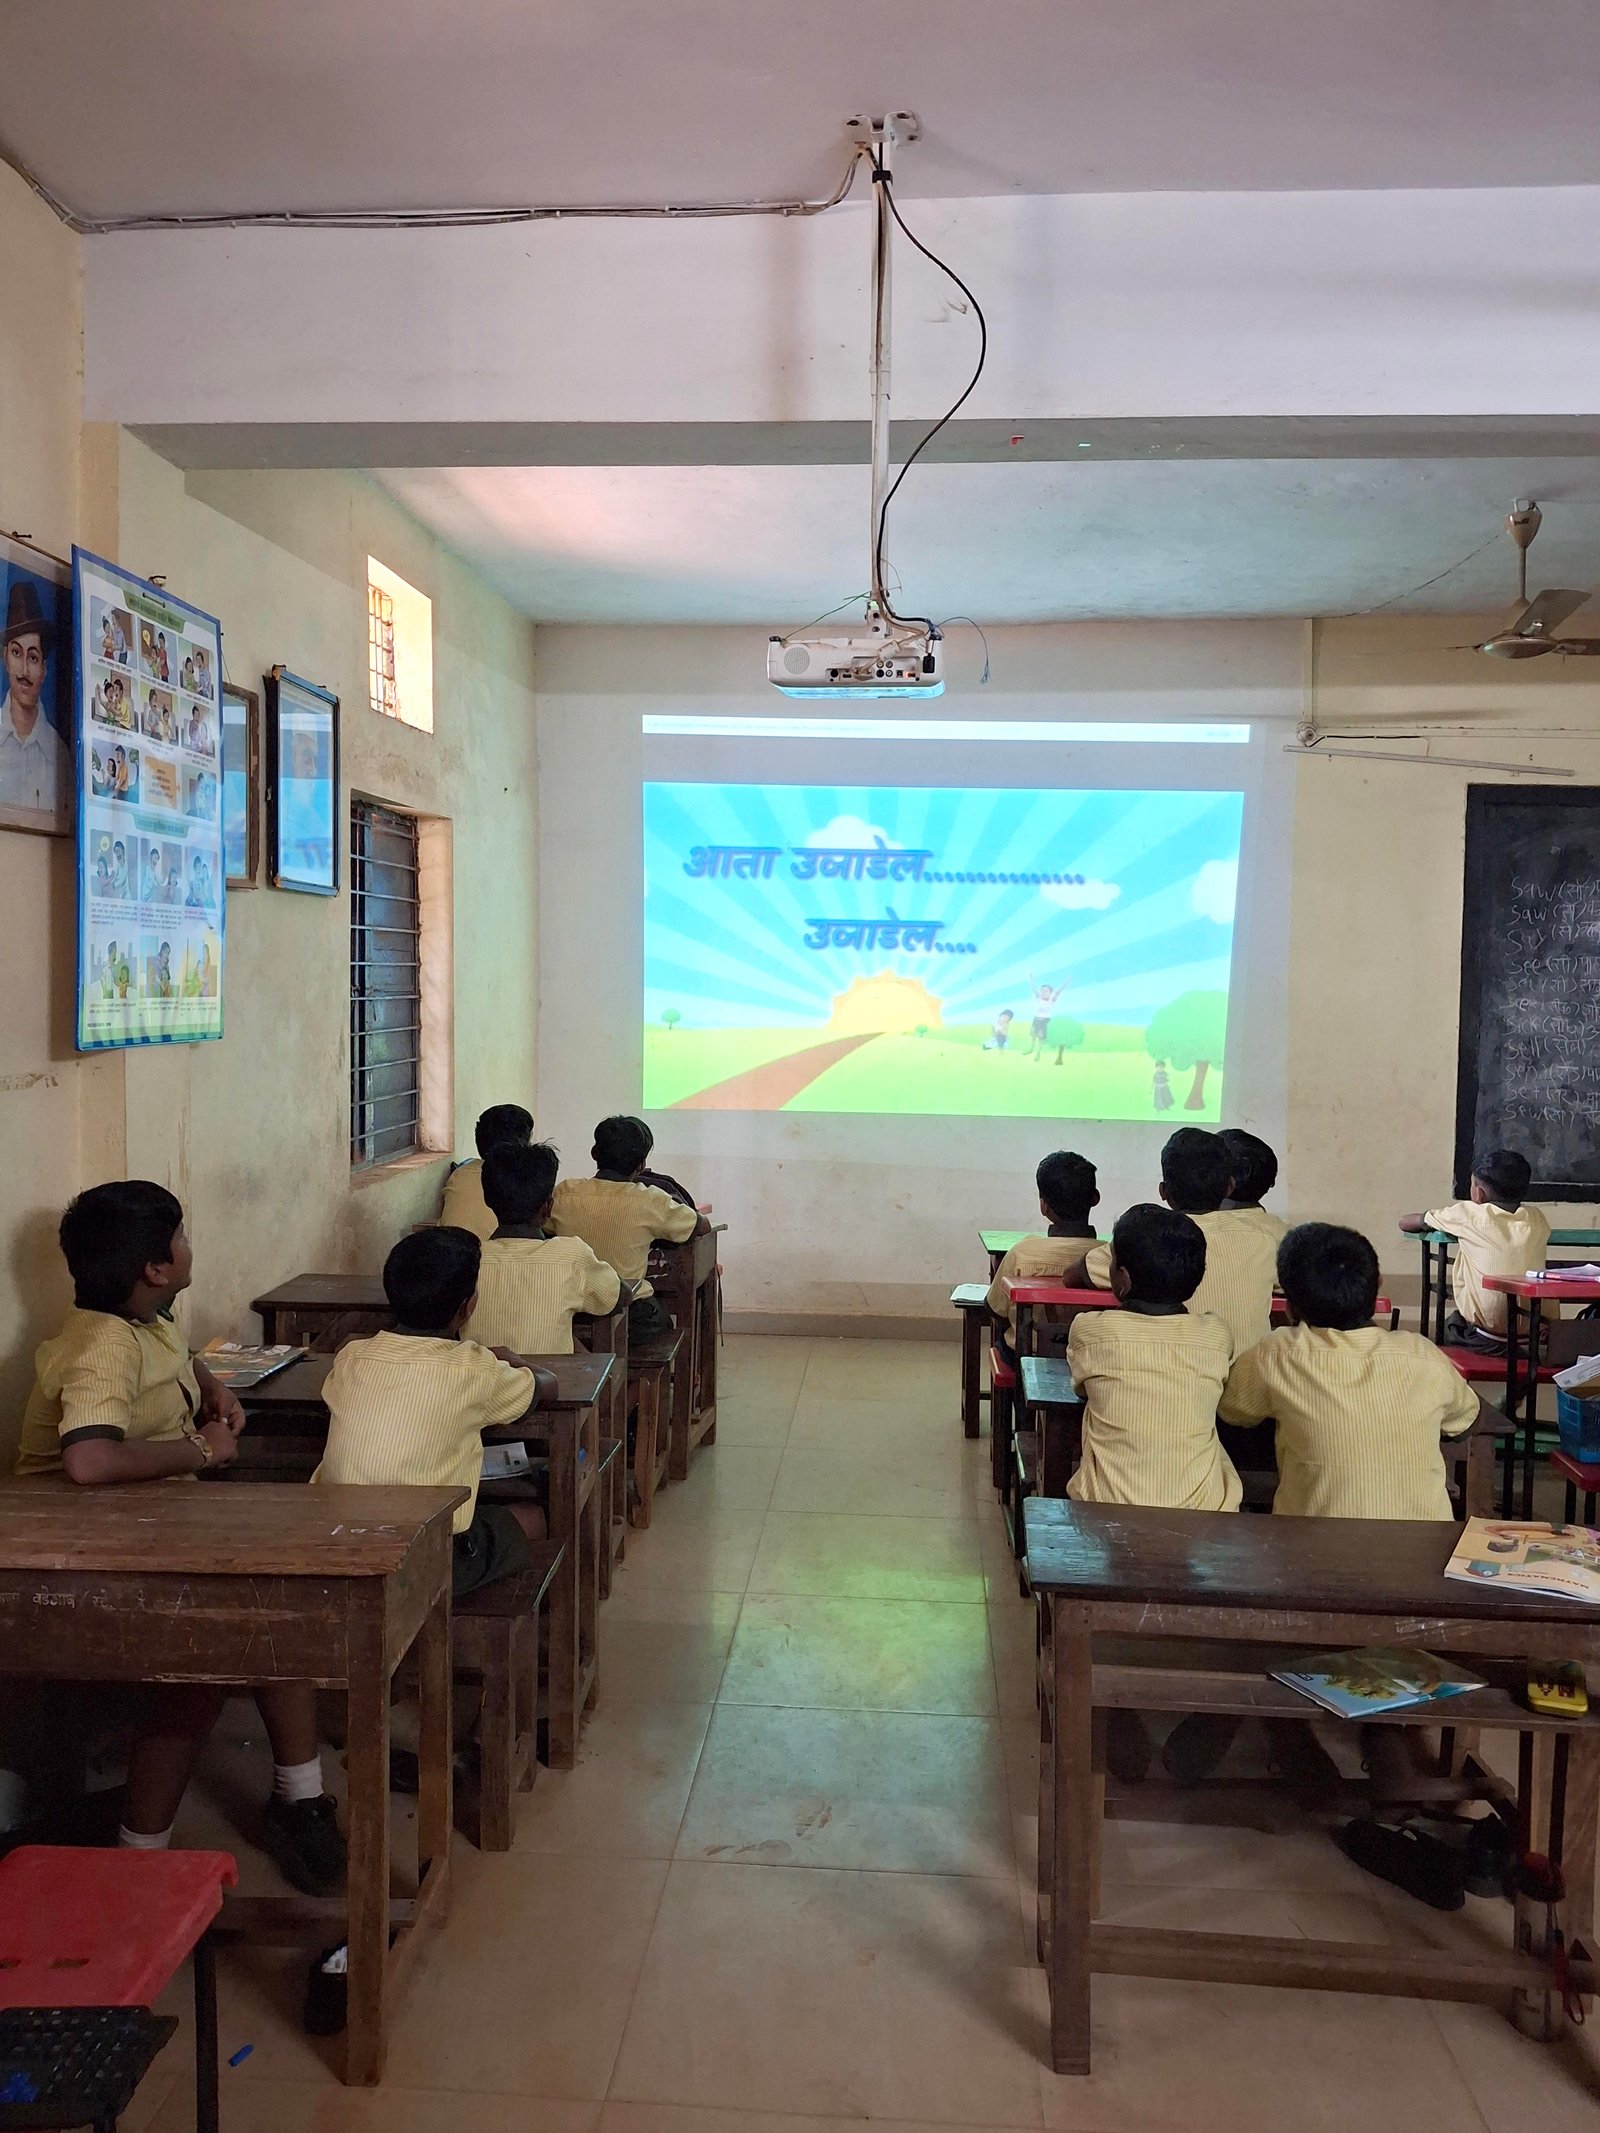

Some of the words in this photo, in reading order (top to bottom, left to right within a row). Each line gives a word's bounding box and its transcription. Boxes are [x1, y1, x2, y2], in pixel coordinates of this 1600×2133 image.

[683, 845, 781, 879] आता
[1511, 876, 1556, 902] Saw
[1506, 905, 1547, 925] Saw
[1509, 959, 1540, 976] See
[1505, 1036, 1540, 1060] Sell
[1506, 1573, 1590, 1590] MATHEMATICS
